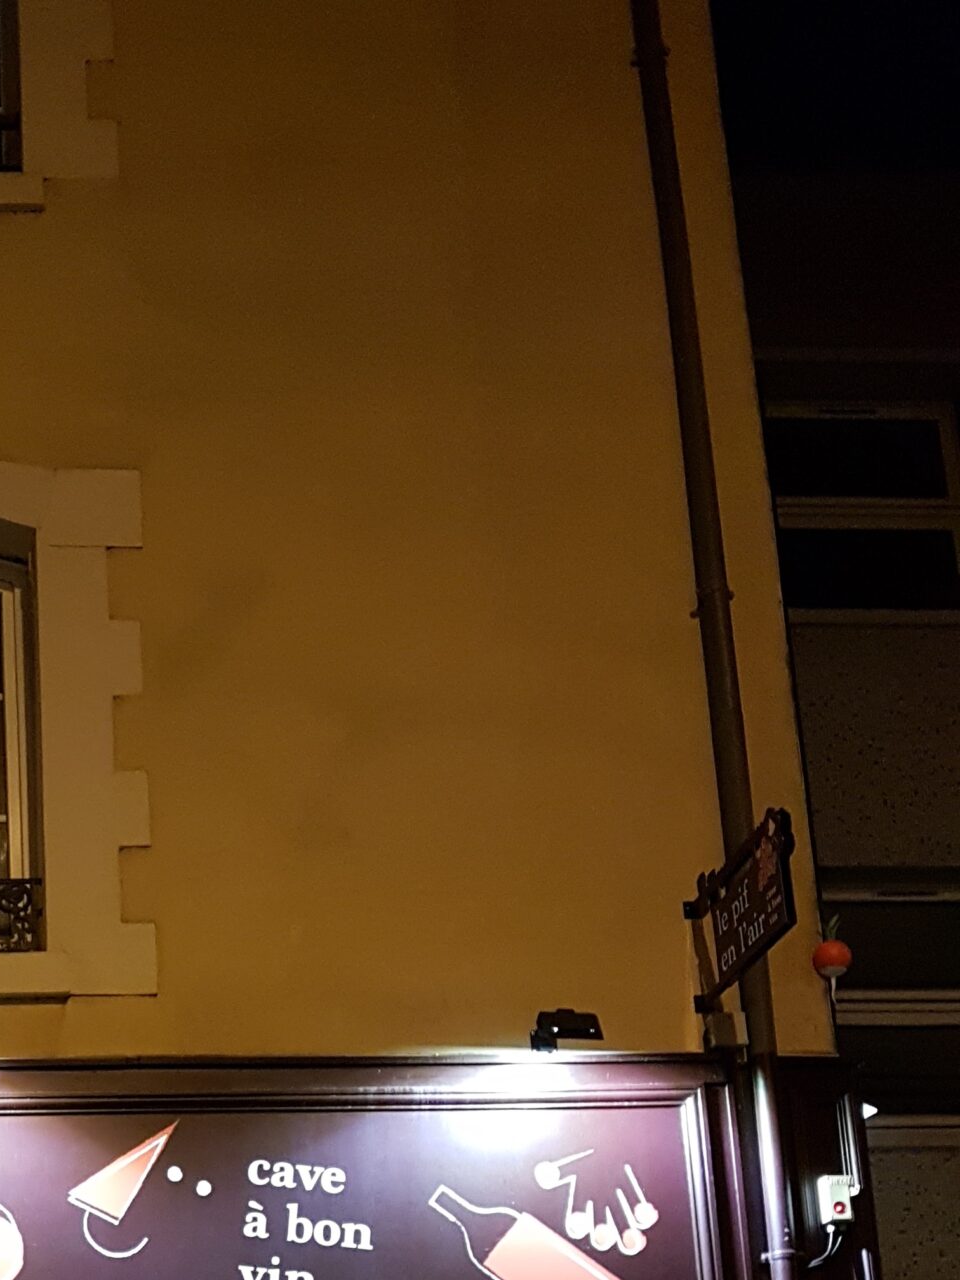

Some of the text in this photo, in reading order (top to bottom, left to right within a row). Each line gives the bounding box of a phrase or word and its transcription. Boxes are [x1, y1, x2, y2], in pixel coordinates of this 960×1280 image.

[716, 878, 749, 935] le pif
[721, 912, 765, 971] en l'air
[247, 1159, 346, 1194] cave
[243, 1200, 373, 1250] à bon
